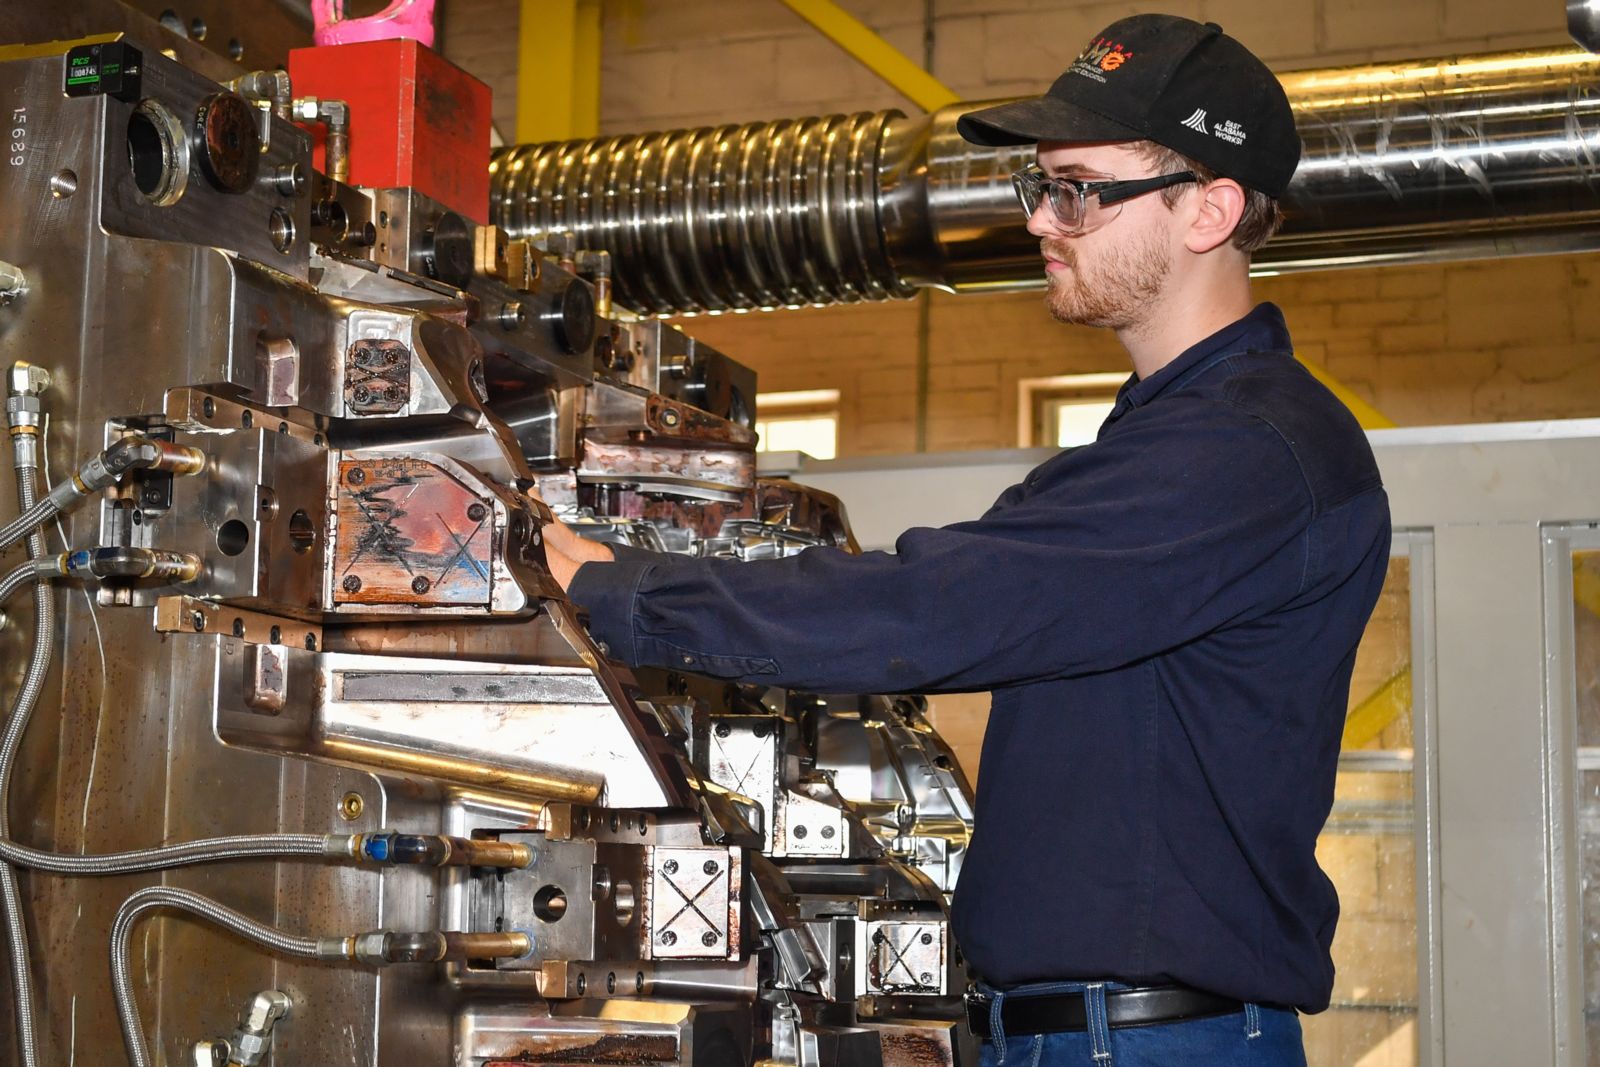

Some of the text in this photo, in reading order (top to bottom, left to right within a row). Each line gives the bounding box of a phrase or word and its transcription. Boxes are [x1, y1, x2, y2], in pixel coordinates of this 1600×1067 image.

[72, 56, 90, 66] PCS
[1213, 122, 1246, 140] ALABAMA
[1225, 119, 1242, 131] EAST
[10, 107, 27, 166] 15689
